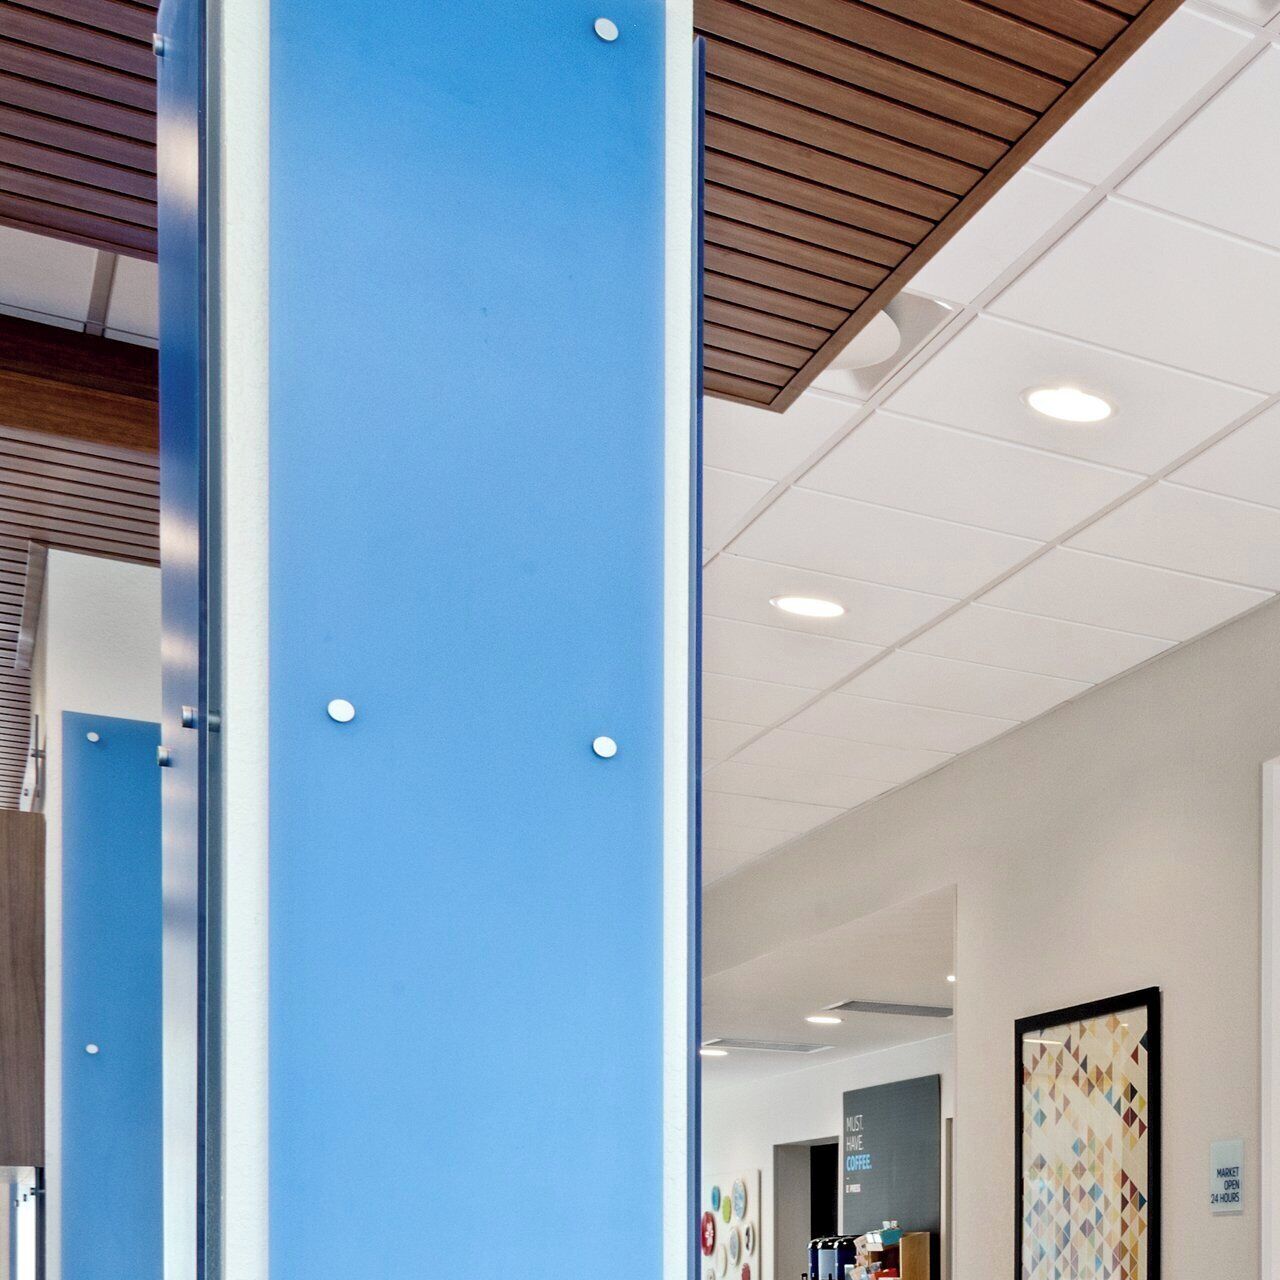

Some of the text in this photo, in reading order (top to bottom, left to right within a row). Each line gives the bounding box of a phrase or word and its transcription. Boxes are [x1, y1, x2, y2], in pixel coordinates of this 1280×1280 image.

[846, 1154, 872, 1172] COFFEE.
[1216, 1166, 1240, 1178] MARKET
[1224, 1180, 1240, 1190] OPEN
[1210, 1192, 1240, 1204] 24 HOURS
